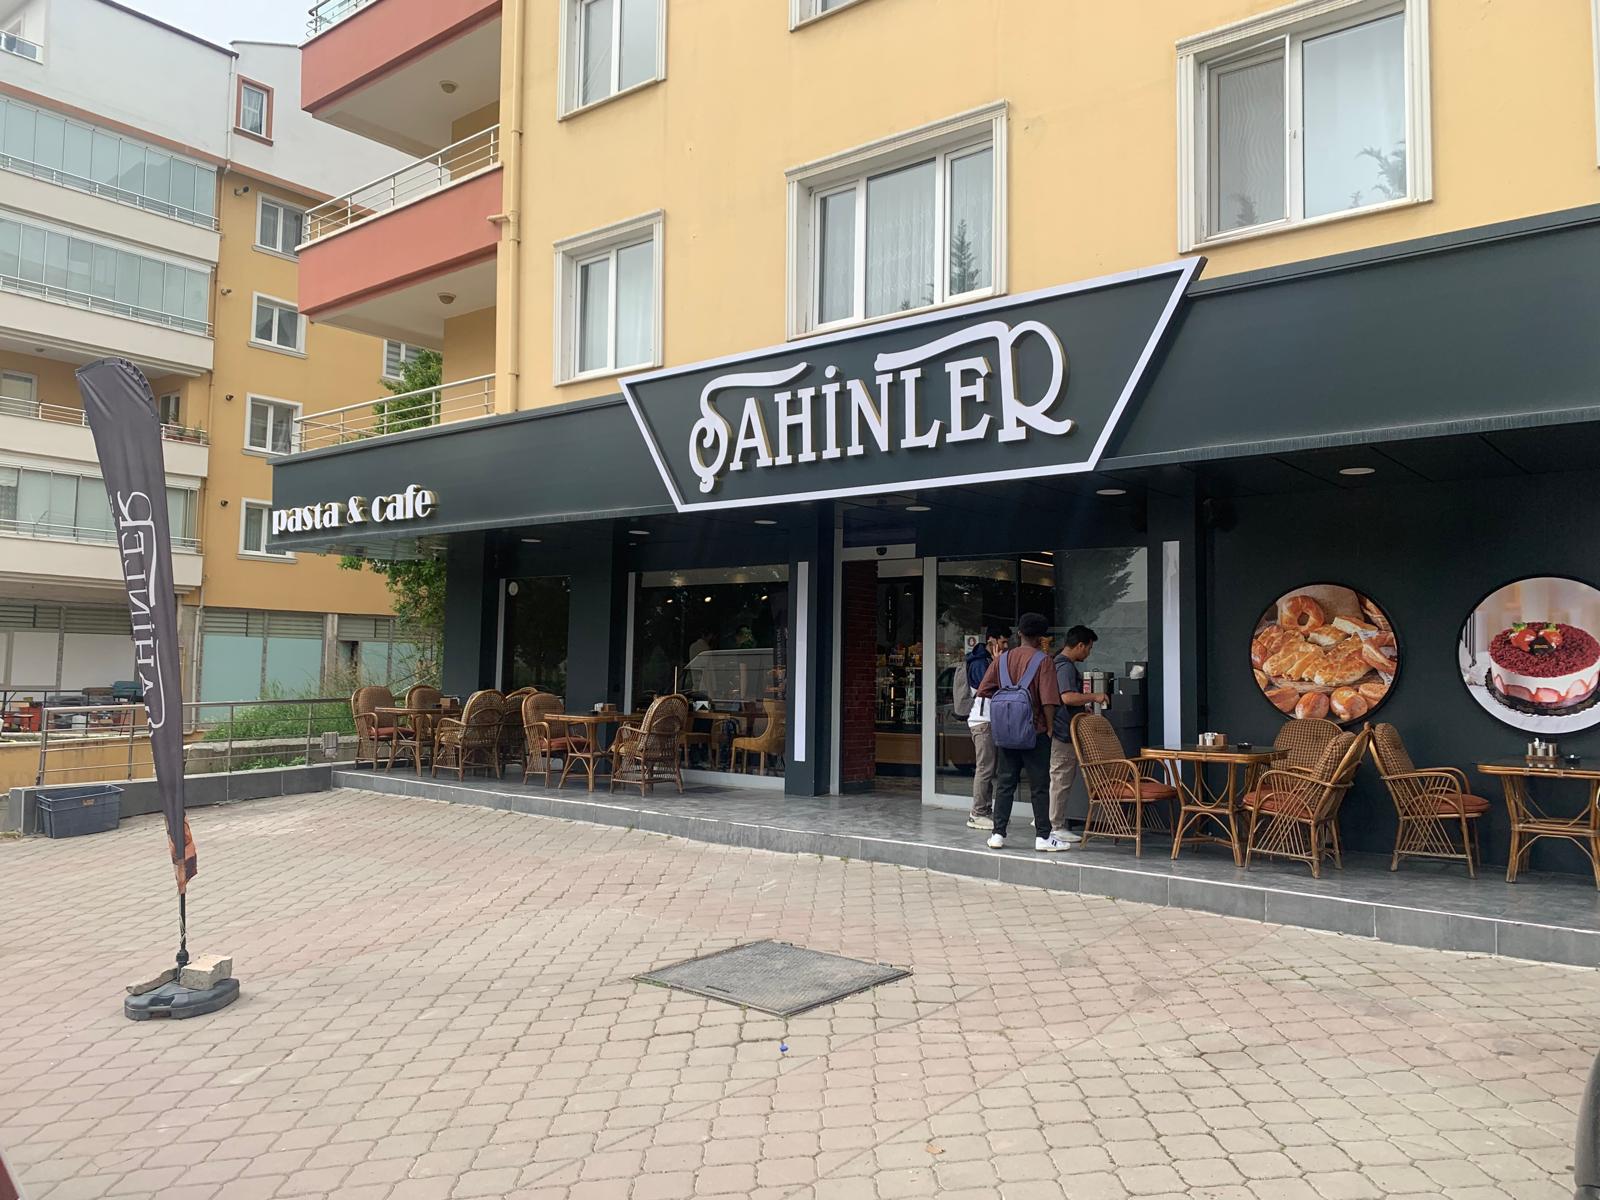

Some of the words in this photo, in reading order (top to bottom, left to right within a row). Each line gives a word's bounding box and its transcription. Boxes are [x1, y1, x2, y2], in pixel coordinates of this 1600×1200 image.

[272, 502, 341, 535] pasta
[346, 495, 367, 524] &
[371, 484, 436, 522] cafe
